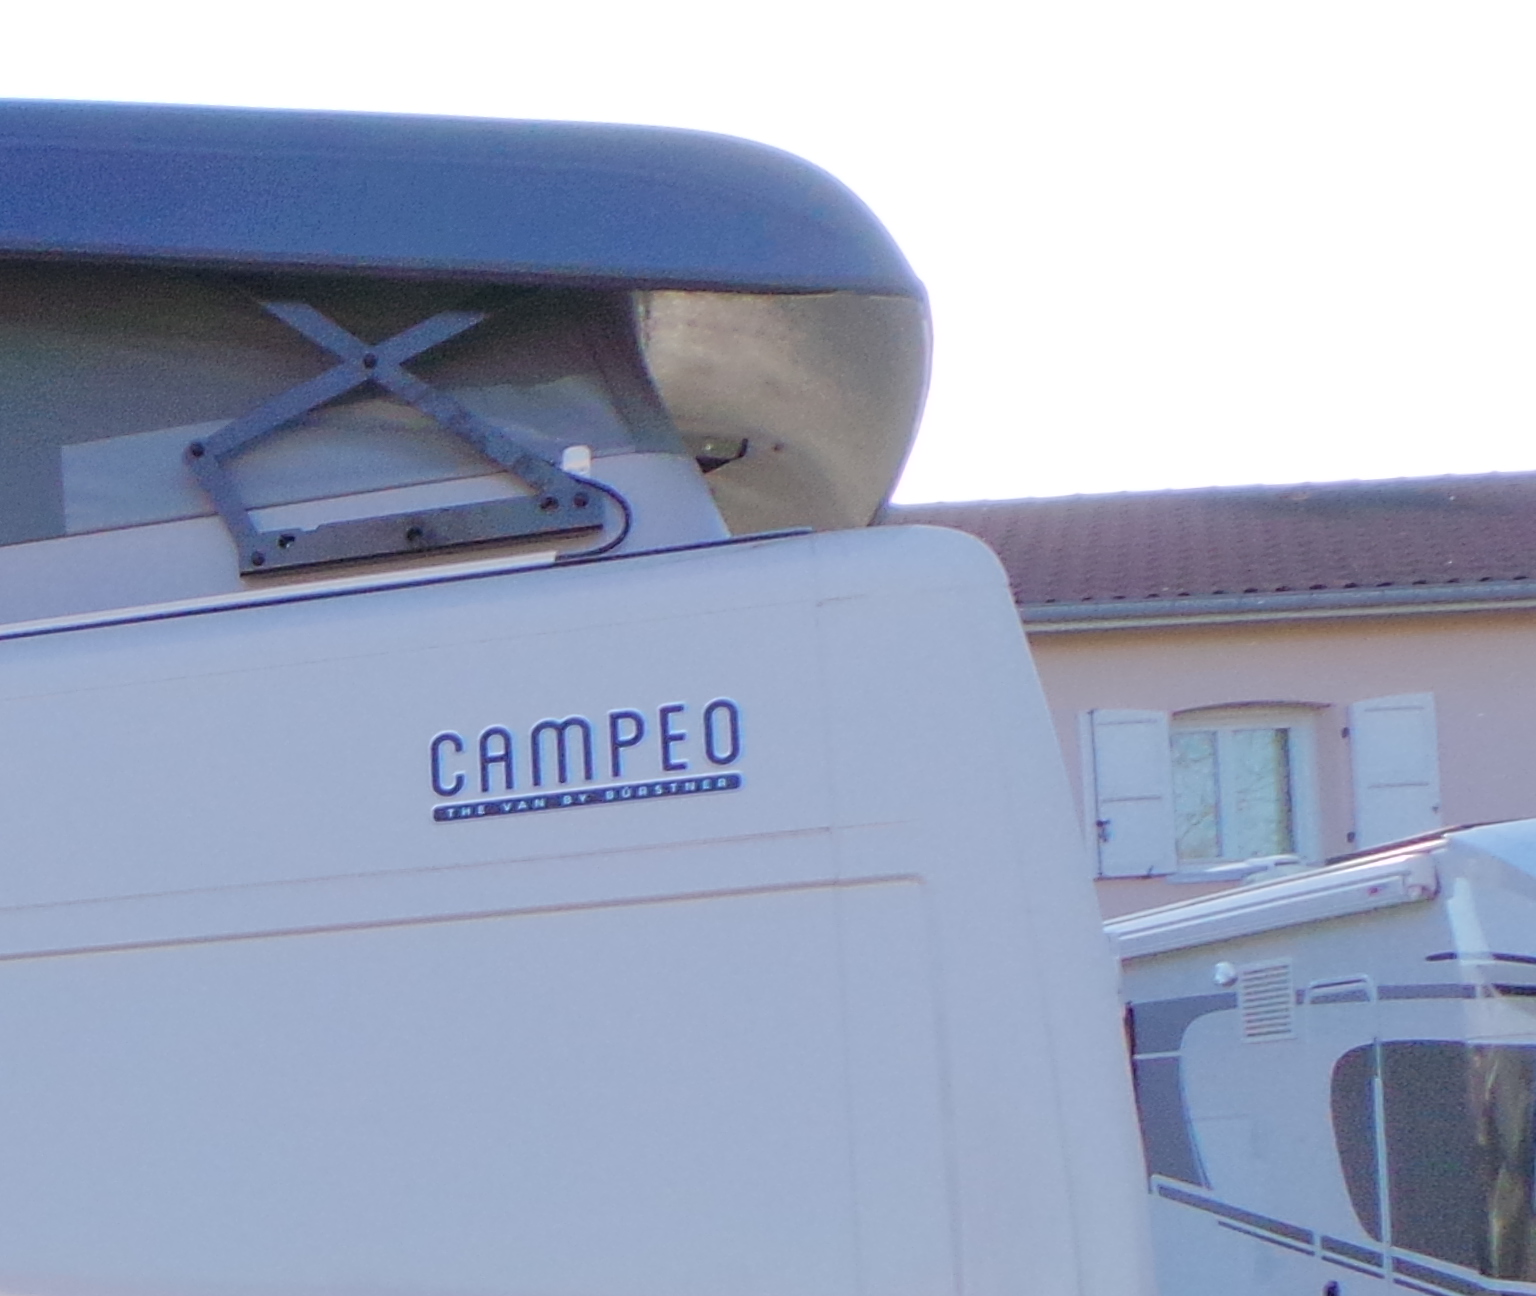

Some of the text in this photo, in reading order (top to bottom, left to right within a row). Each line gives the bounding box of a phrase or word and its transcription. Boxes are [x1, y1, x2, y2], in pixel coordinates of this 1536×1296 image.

[430, 698, 741, 797] CAMPEO
[446, 805, 486, 819] THE
[501, 798, 546, 813] VAN
[561, 792, 589, 806] BY
